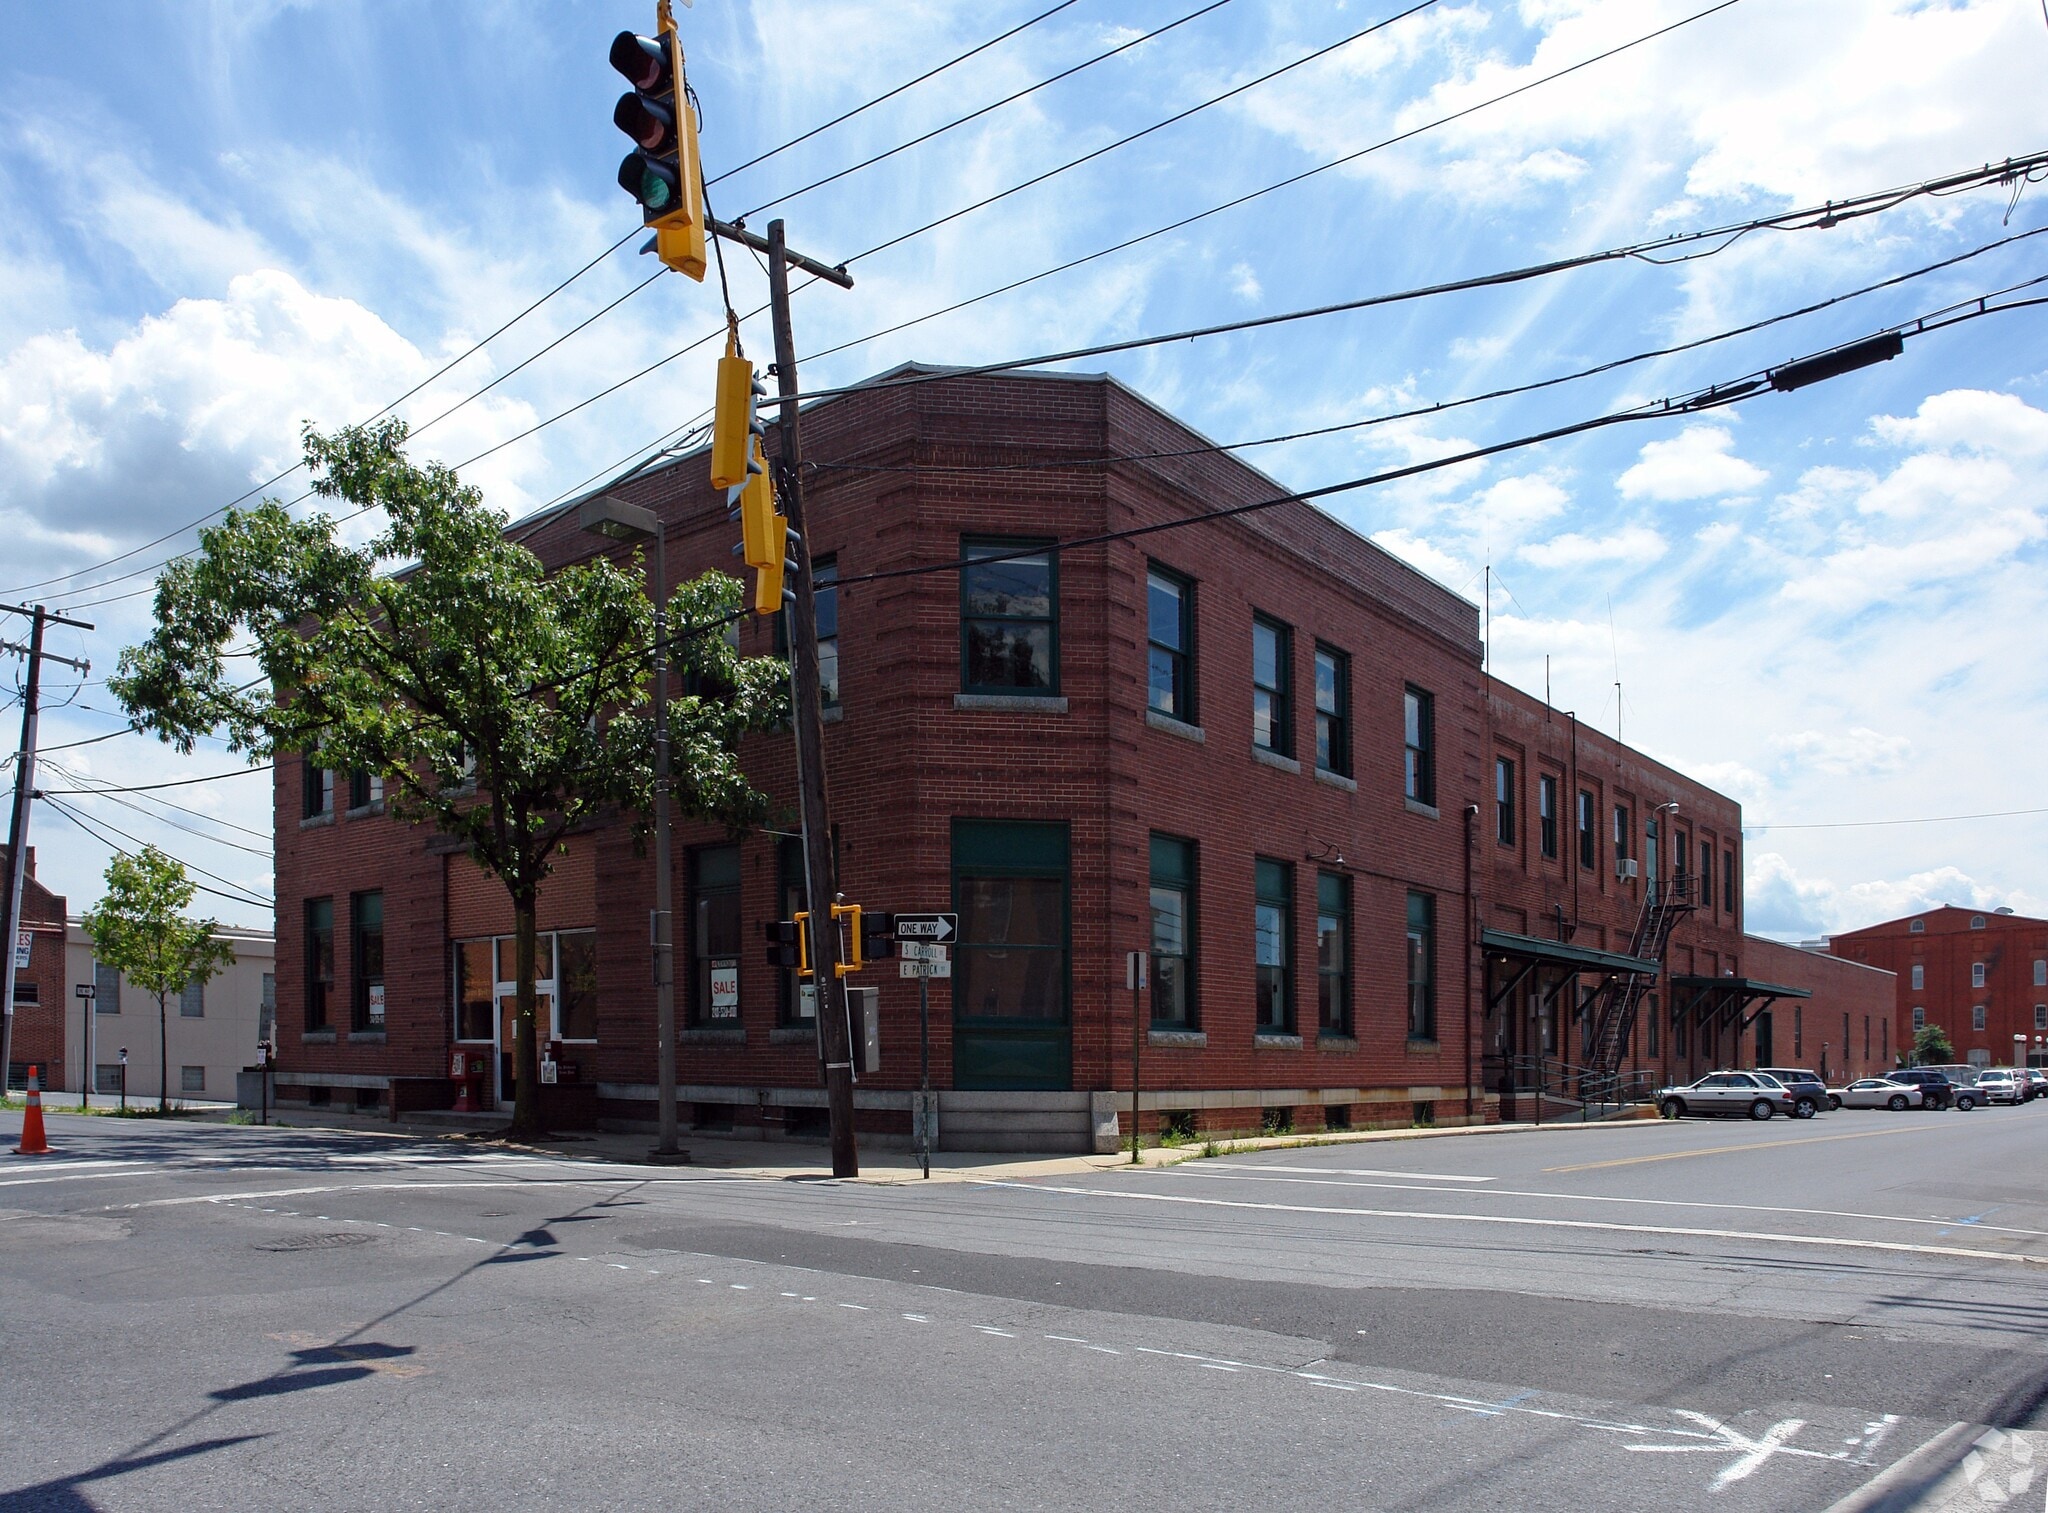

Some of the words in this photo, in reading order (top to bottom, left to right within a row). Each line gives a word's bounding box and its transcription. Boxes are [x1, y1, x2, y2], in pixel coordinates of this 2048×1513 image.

[900, 924, 917, 934] ONE
[920, 924, 937, 934] WAY
[905, 944, 908, 954] S
[914, 946, 937, 958] CARROLL
[904, 965, 907, 975] E
[913, 964, 937, 975] PATRICK
[713, 980, 736, 994] SALE
[370, 995, 384, 1005] SALE
